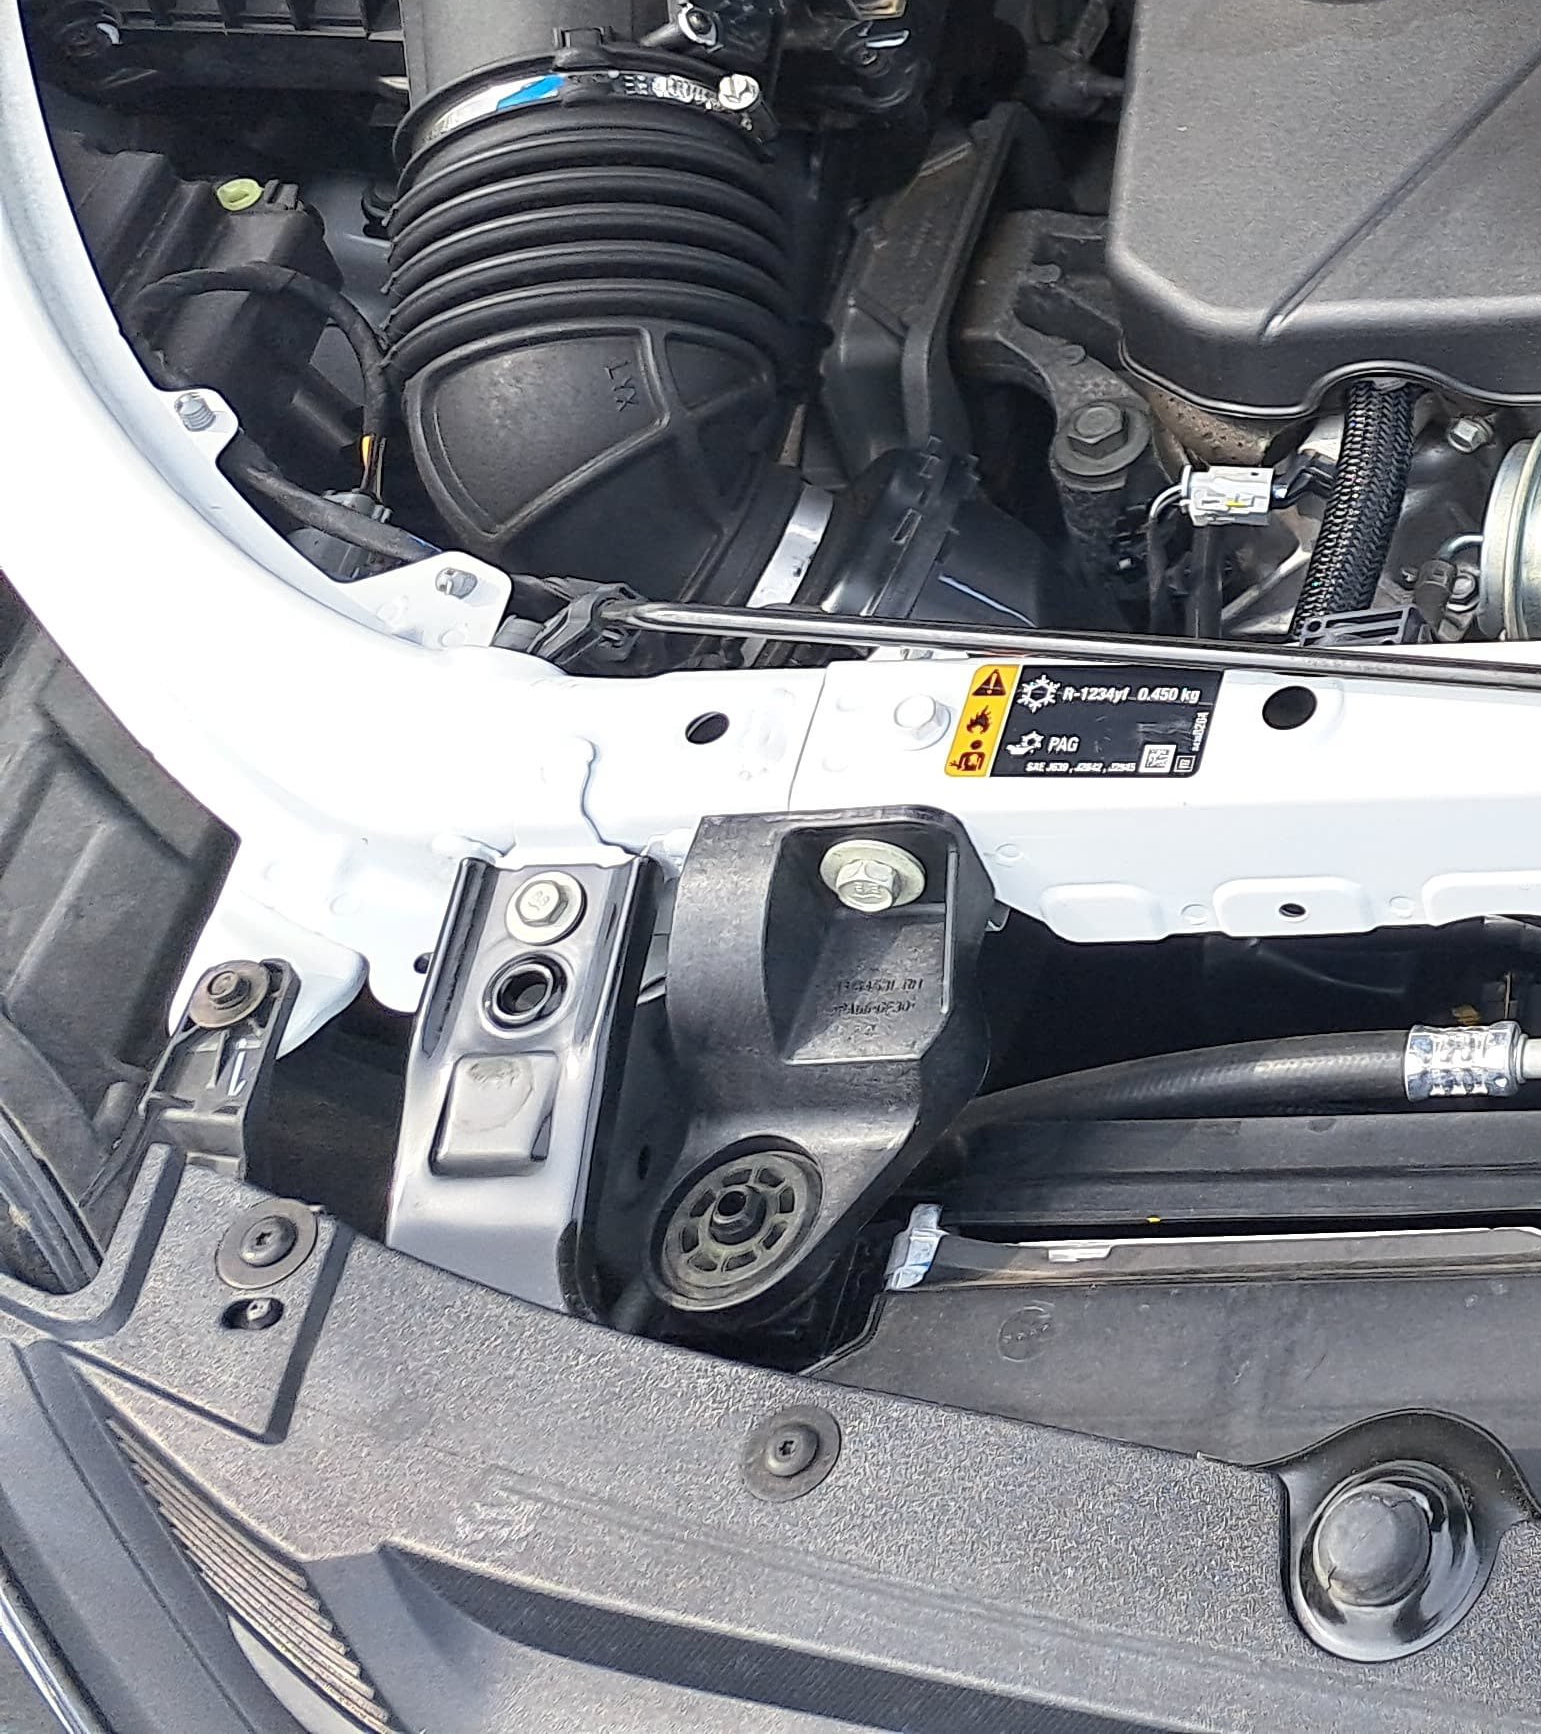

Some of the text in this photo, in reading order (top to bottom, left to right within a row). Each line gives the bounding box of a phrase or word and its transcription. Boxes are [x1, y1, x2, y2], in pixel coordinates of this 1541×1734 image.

[1062, 686, 1201, 706] R-1234yf 0.450 kg
[1047, 736, 1080, 753] PAG
[1025, 761, 1046, 772] SAE
